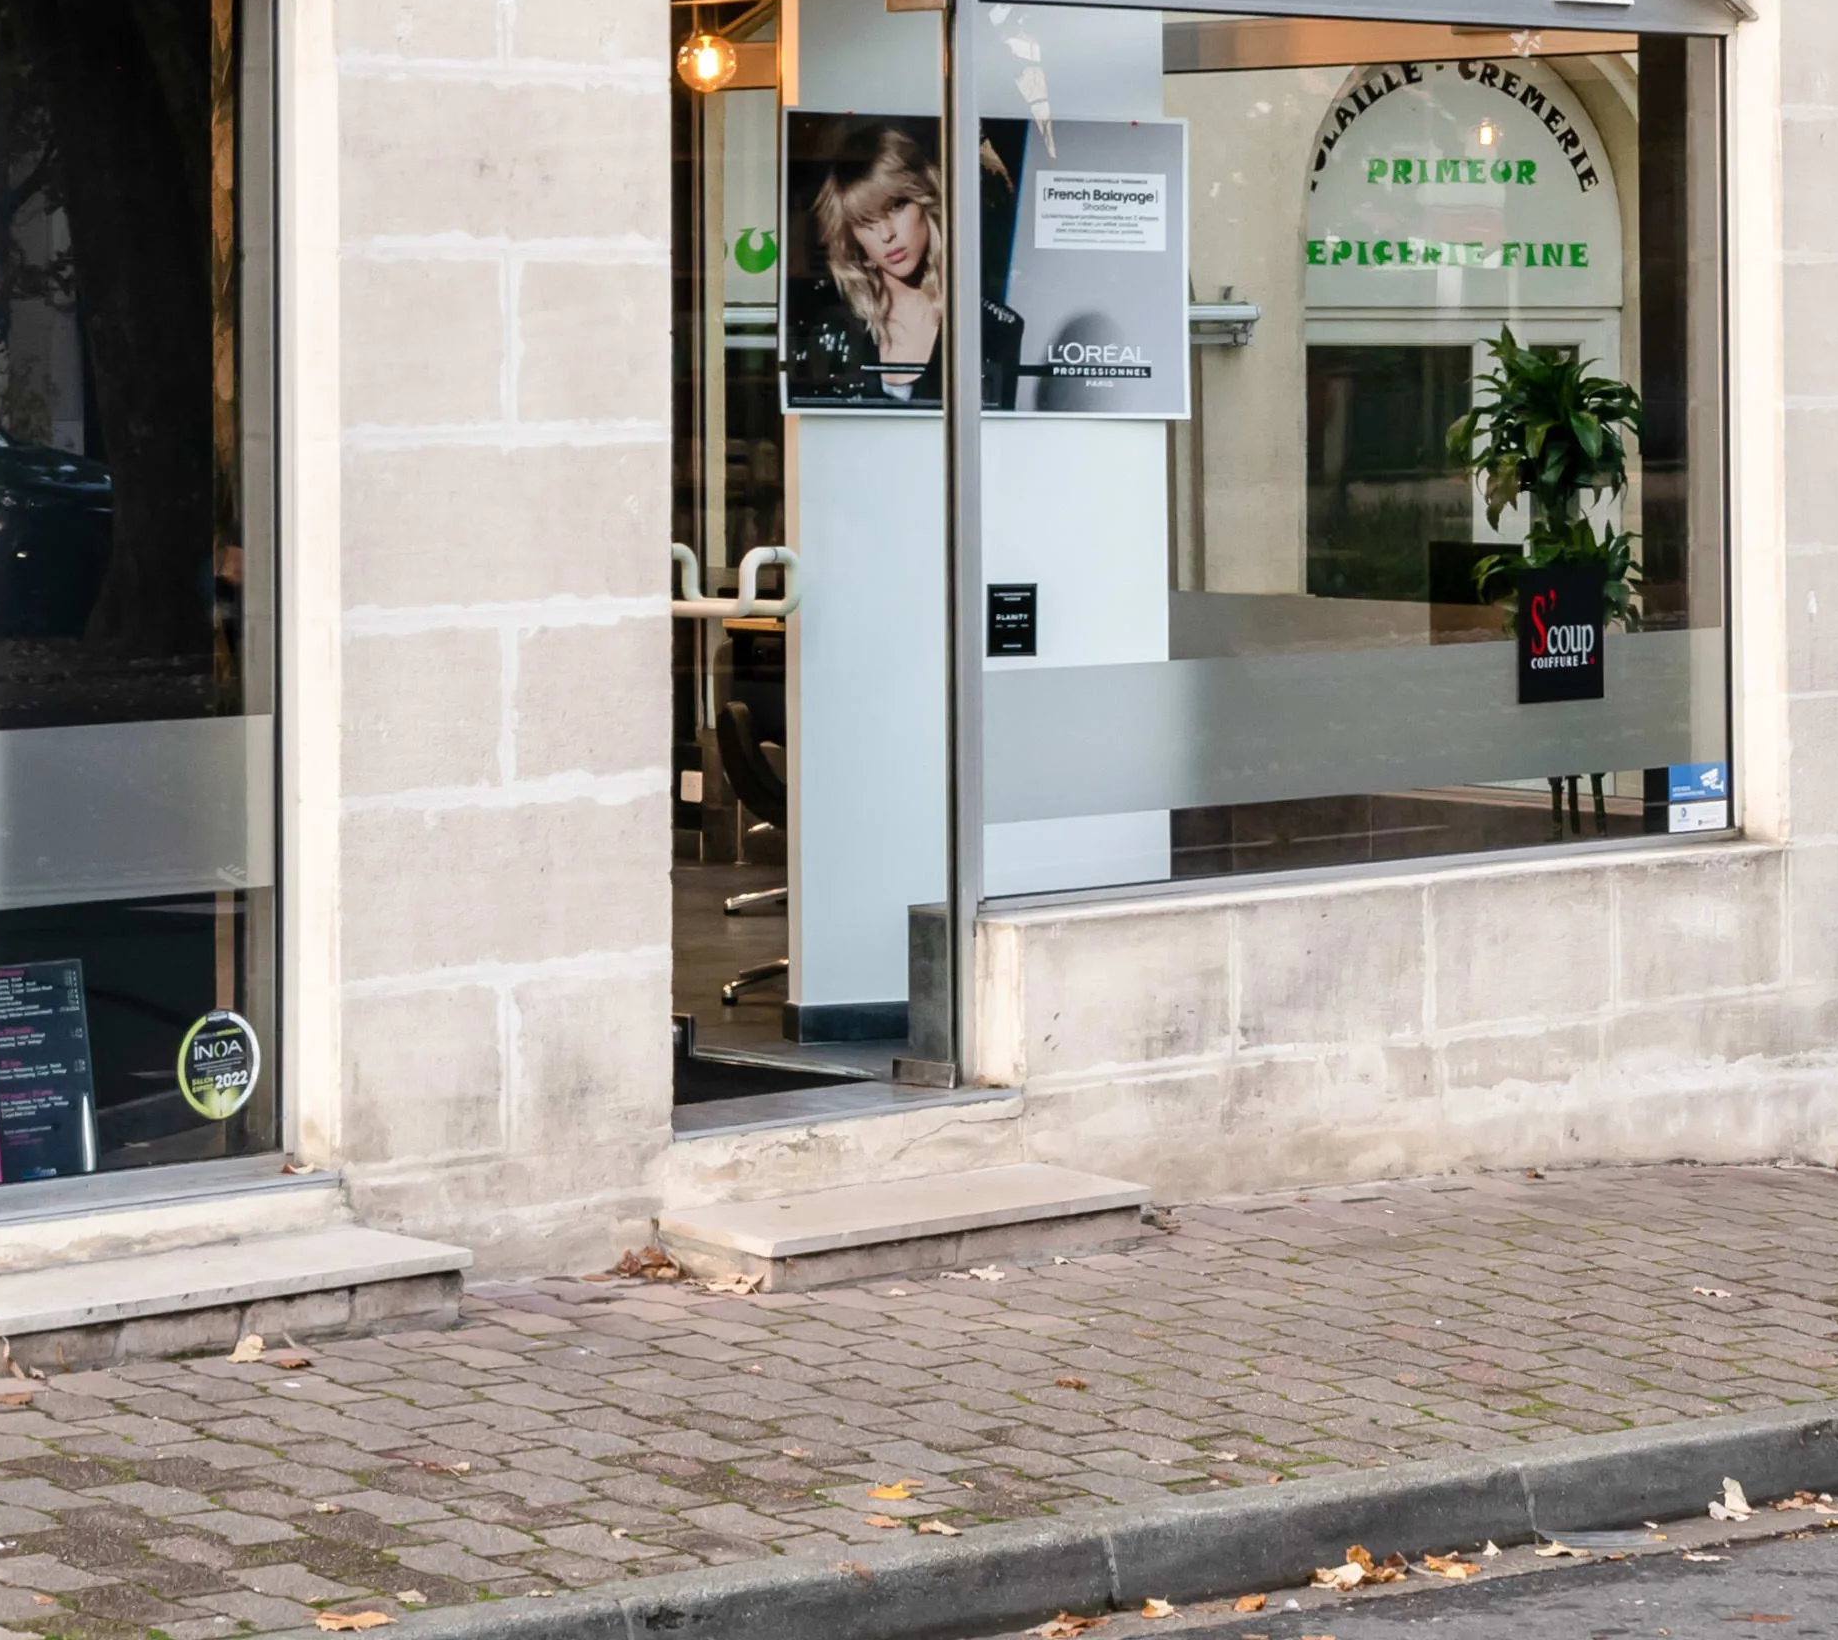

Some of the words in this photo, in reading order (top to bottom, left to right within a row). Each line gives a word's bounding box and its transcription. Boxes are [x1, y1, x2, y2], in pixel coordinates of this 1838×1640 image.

[1311, 61, 1424, 193] OLAILLE
[1458, 60, 1599, 194] CREMERIE
[1367, 157, 1537, 185] PRIMEUR
[1307, 240, 1485, 266] EPICERIE
[1502, 242, 1590, 267] FINE
[1047, 342, 1152, 364] L'ORÉAL
[1052, 366, 1148, 376] PROFESSIONNEL
[1530, 654, 1579, 670] COIFFURE
[215, 1070, 248, 1090] 2022
